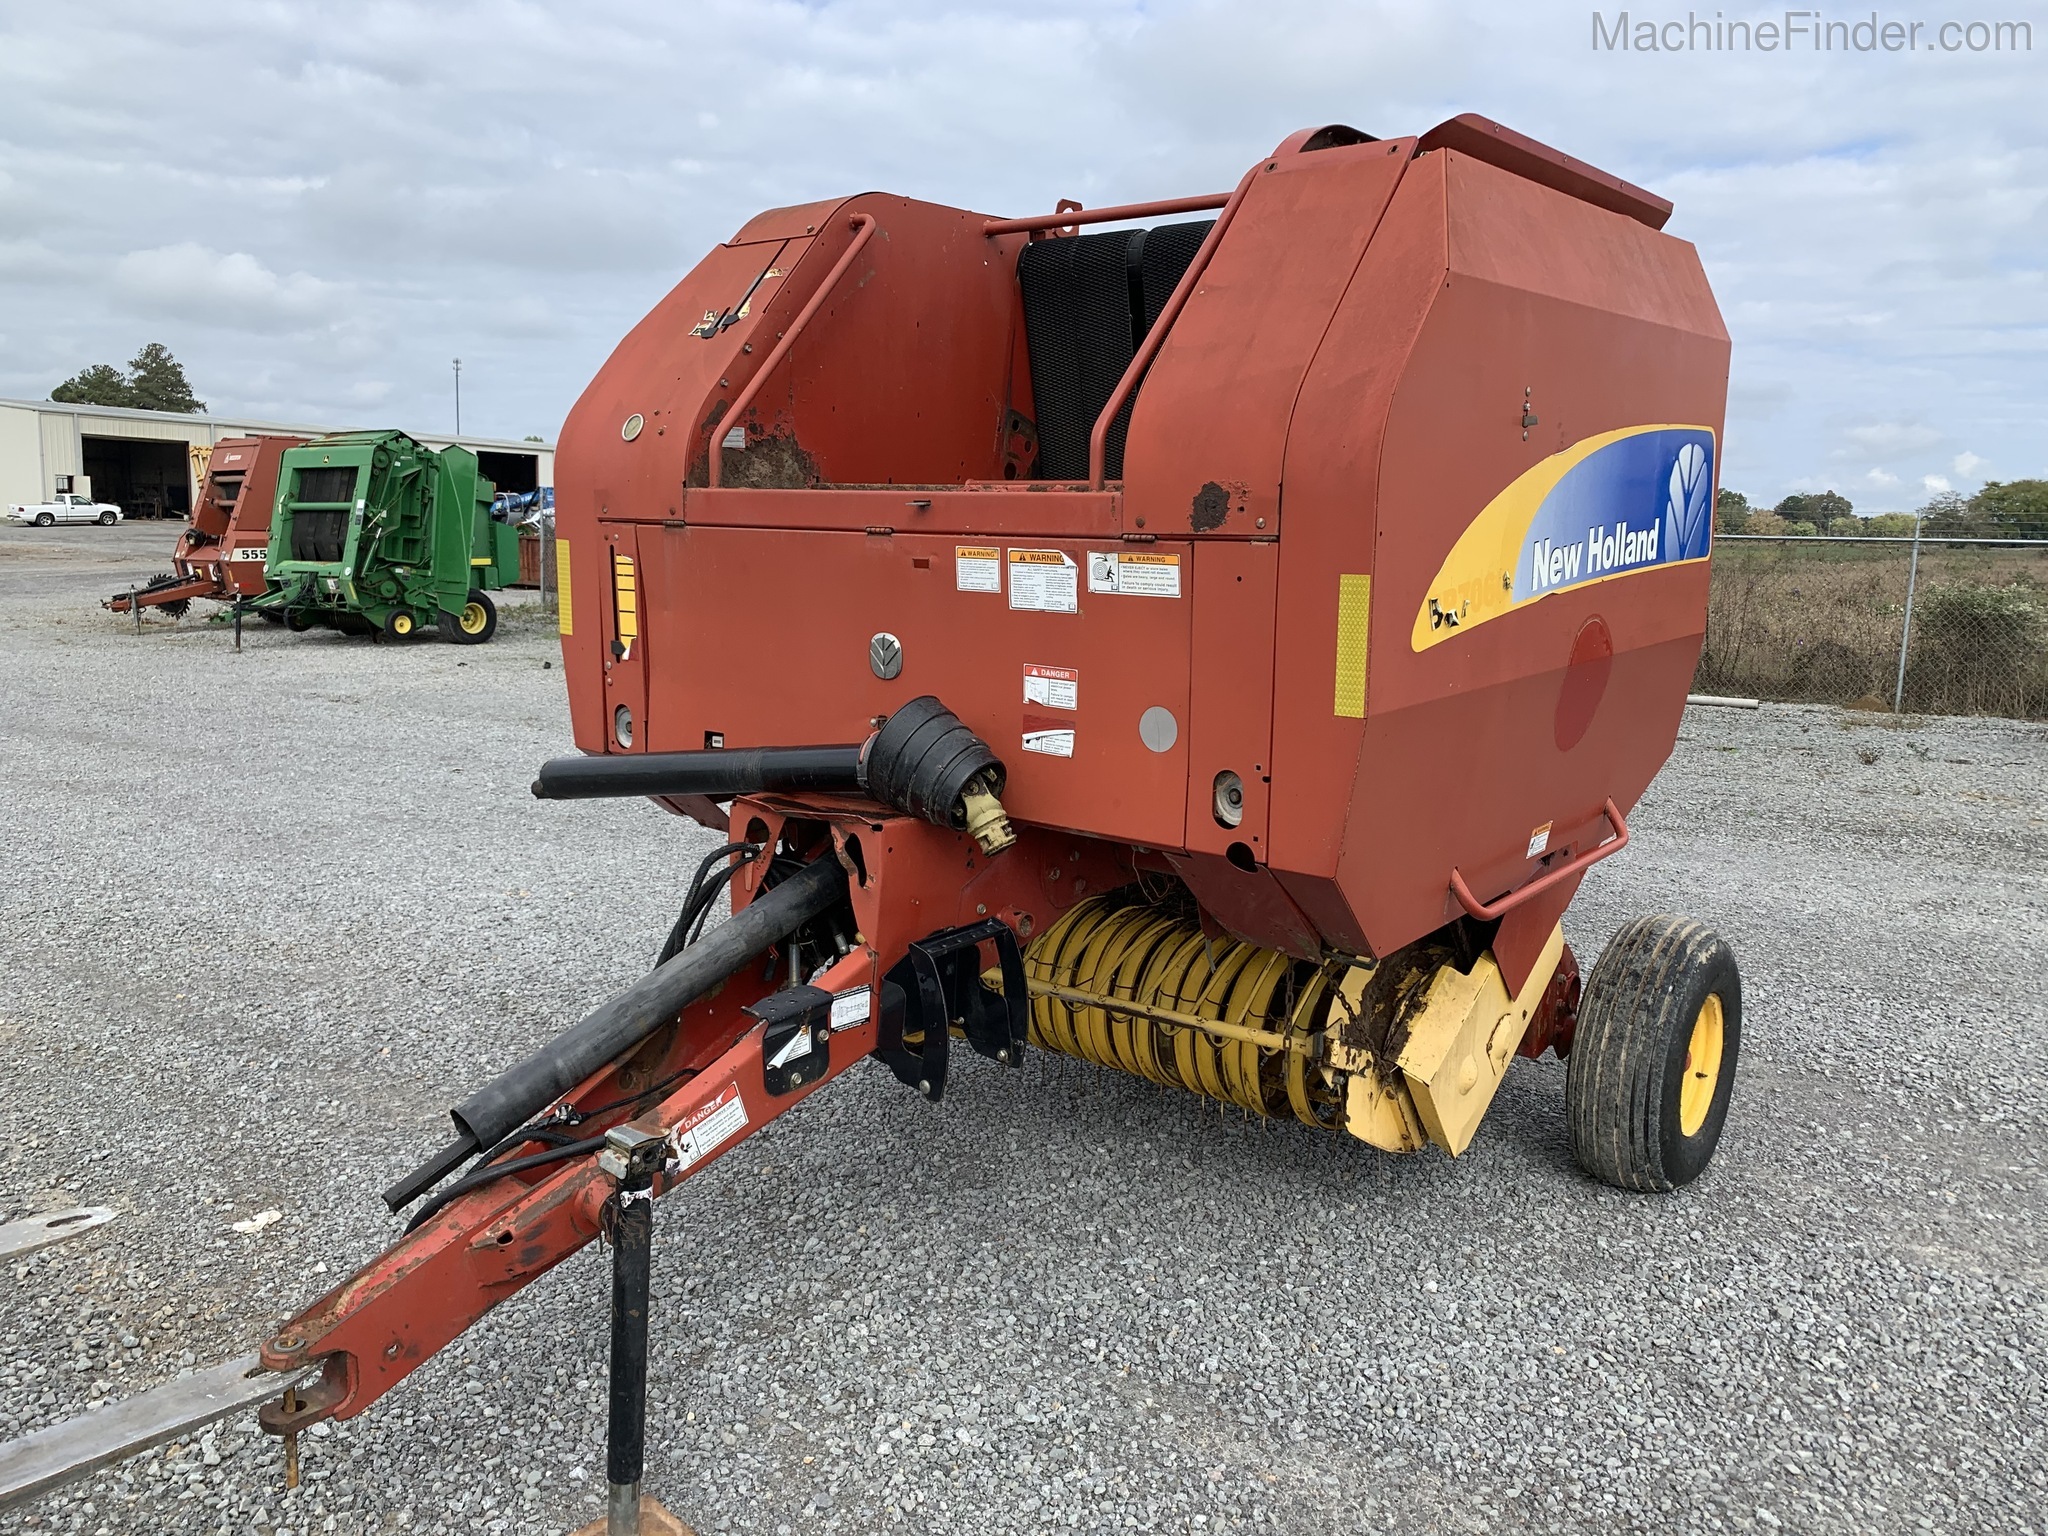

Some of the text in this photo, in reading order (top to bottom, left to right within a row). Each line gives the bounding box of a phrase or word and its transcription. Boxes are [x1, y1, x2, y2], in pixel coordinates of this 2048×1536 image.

[1029, 554, 1064, 562] WARNING
[1532, 517, 1660, 591] New Holland
[1041, 669, 1070, 678] DANGER
[684, 1100, 722, 1129] DANGER
